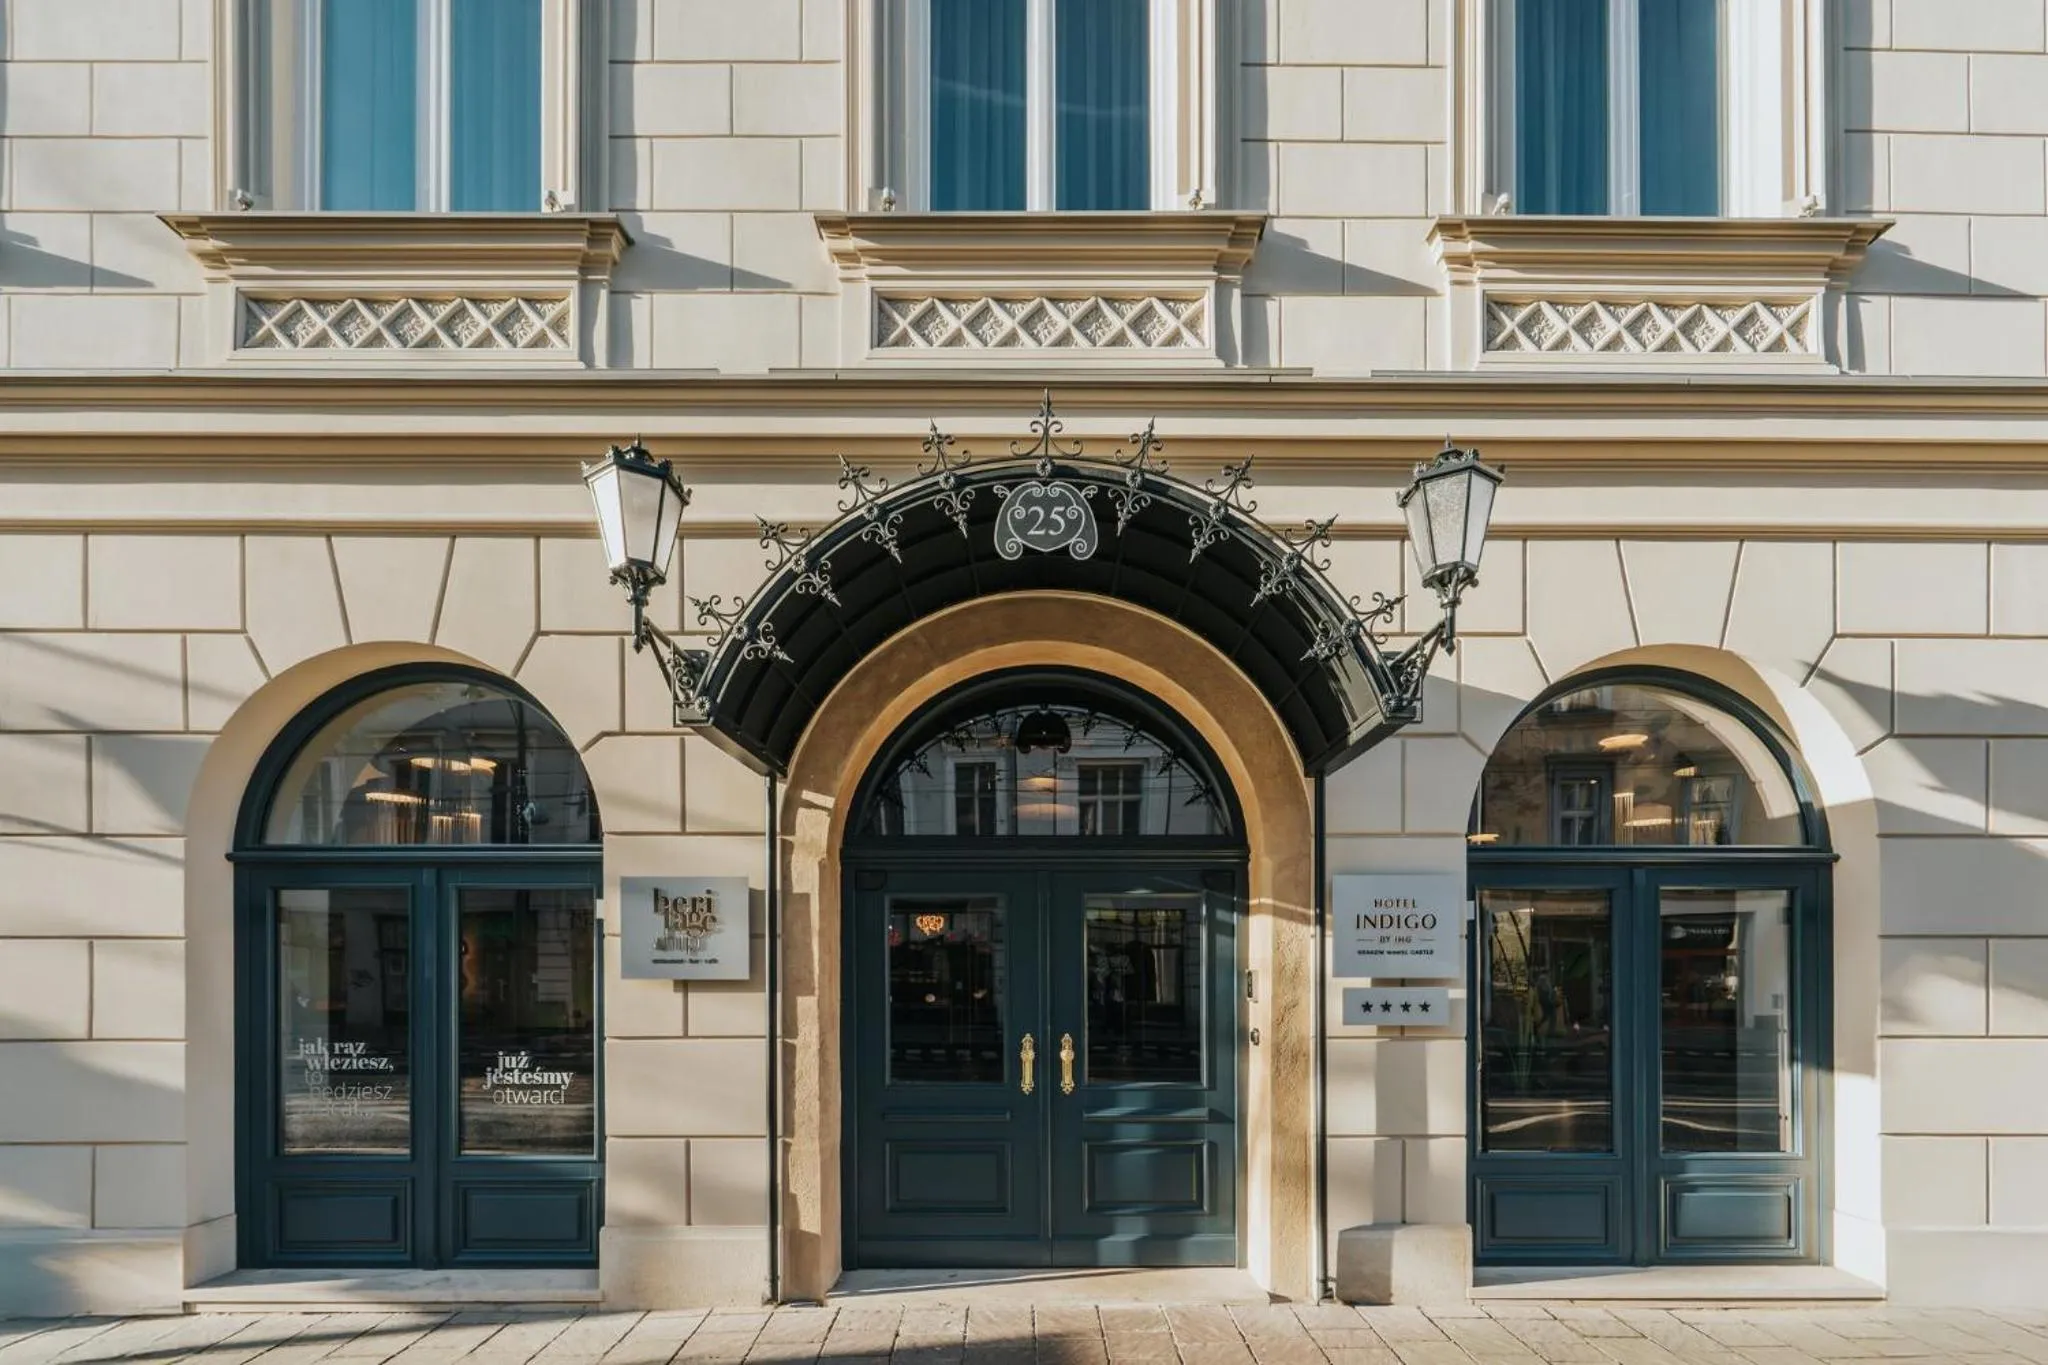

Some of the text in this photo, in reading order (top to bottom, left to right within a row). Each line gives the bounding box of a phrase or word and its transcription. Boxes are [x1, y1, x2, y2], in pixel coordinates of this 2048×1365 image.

[1027, 506, 1065, 535] 25
[1374, 898, 1417, 908] HOTEL
[1356, 914, 1437, 930] INDIGO
[497, 1051, 529, 1072] już
[483, 1067, 574, 1089] jesteśmy
[493, 1088, 565, 1104] otwarci
